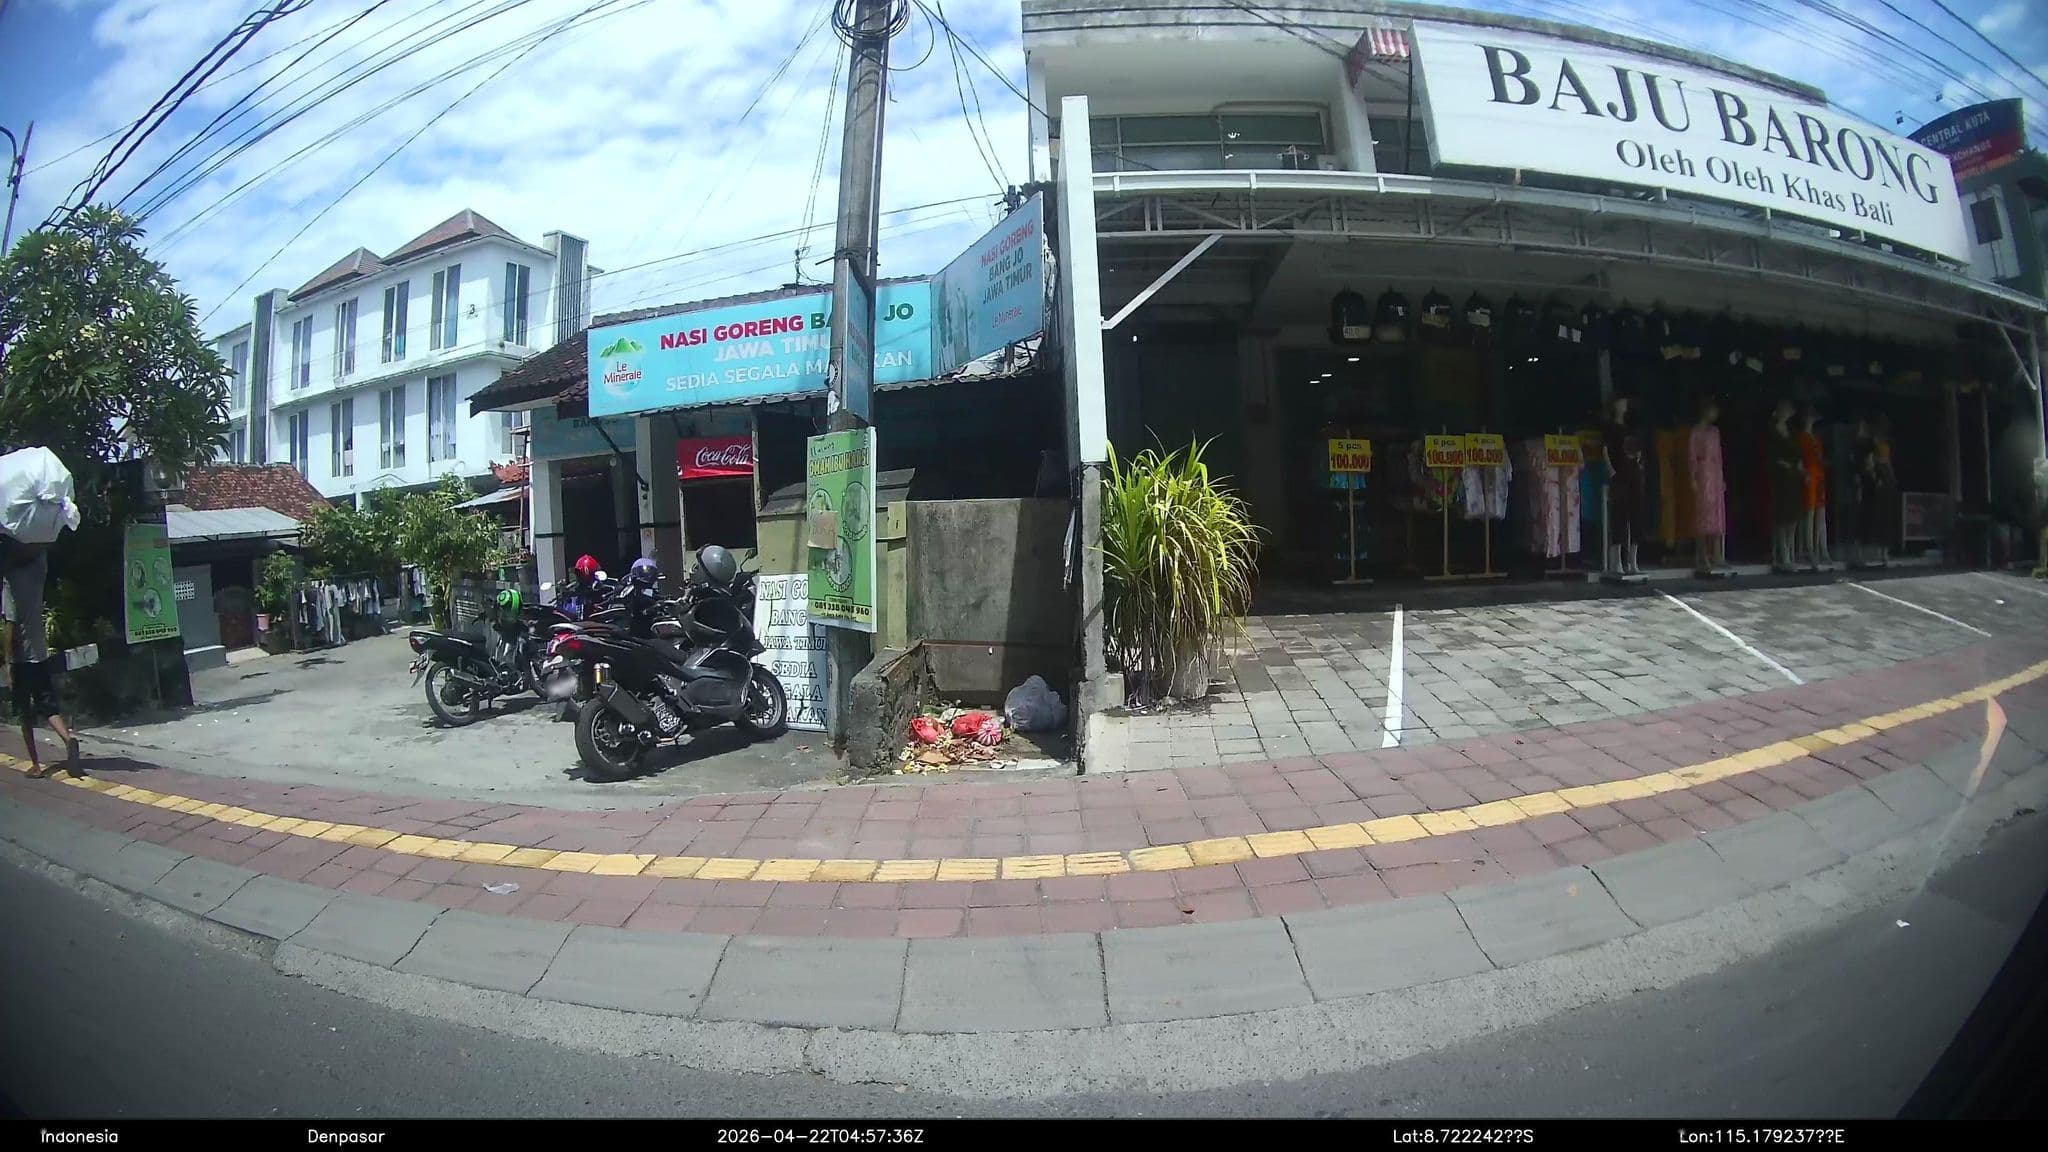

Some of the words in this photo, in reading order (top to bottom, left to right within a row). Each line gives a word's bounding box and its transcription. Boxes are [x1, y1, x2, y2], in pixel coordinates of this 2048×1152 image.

[1474, 44, 1690, 133] BAJU
[1709, 88, 1939, 204] BARONG
[1965, 111, 1991, 130] KUTA
[1616, 138, 1696, 177] Oleh
[1706, 155, 1774, 194] Oleh
[1782, 172, 1846, 212] Khas
[1851, 191, 1894, 226] Bali
[981, 247, 998, 268] NASI
[1000, 219, 1034, 254] GORENG
[989, 256, 1011, 282] BANG
[1013, 247, 1024, 266] JO
[982, 276, 1004, 305] JAWA
[1006, 262, 1033, 291] TIMUR
[660, 328, 708, 350] NASI
[713, 315, 804, 342] GORENG
[883, 302, 914, 322] JO
[713, 339, 775, 362] JAWA
[780, 333, 831, 354] TIMU
[604, 369, 642, 384] Minerale
[616, 361, 627, 373] Le
[665, 371, 720, 392] SEDIA
[724, 360, 801, 383] SEGALA
[695, 444, 753, 467] Coca-Cola
[1331, 453, 1370, 469] 100.000
[760, 579, 788, 601] NASI
[771, 609, 808, 627] BANG
[764, 635, 792, 650] JAWA
[793, 635, 827, 651] TIMU
[771, 660, 817, 678] SEDIA
